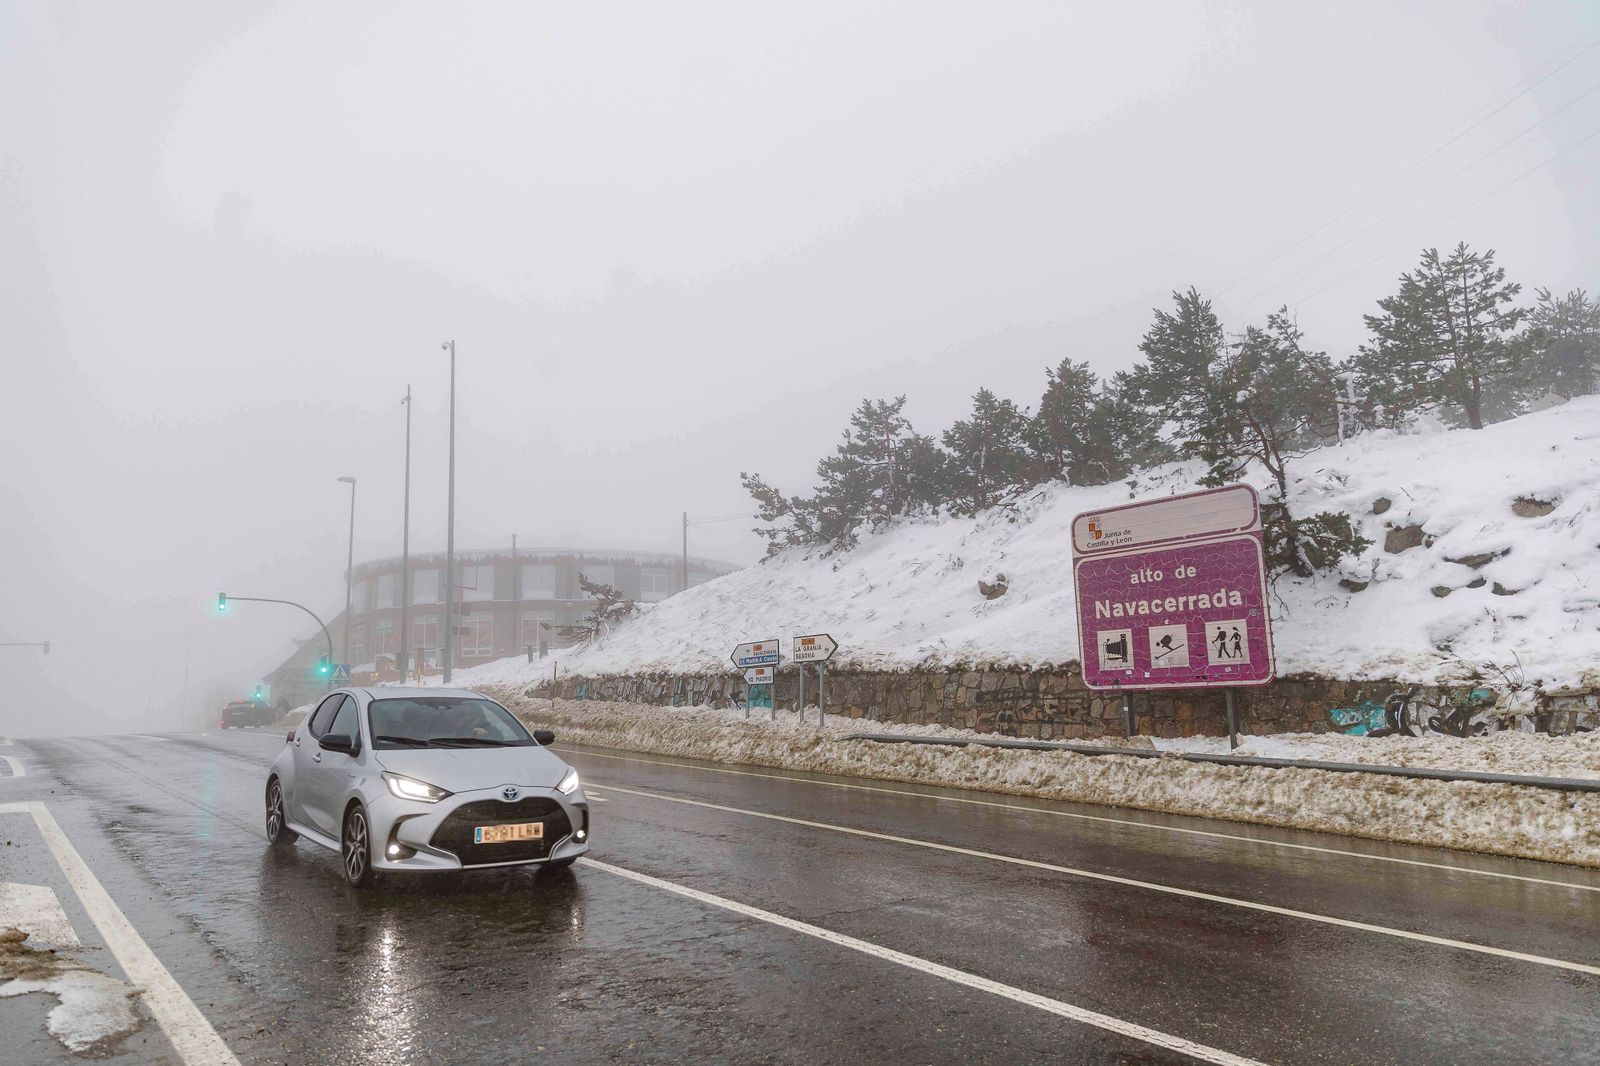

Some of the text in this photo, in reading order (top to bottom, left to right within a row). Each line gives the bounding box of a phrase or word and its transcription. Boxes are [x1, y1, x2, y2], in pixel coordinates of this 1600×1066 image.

[1087, 540, 1109, 549] Castilla
[1116, 536, 1132, 544] León
[1130, 564, 1197, 584] alto de
[1095, 588, 1243, 619] Navacerrada
